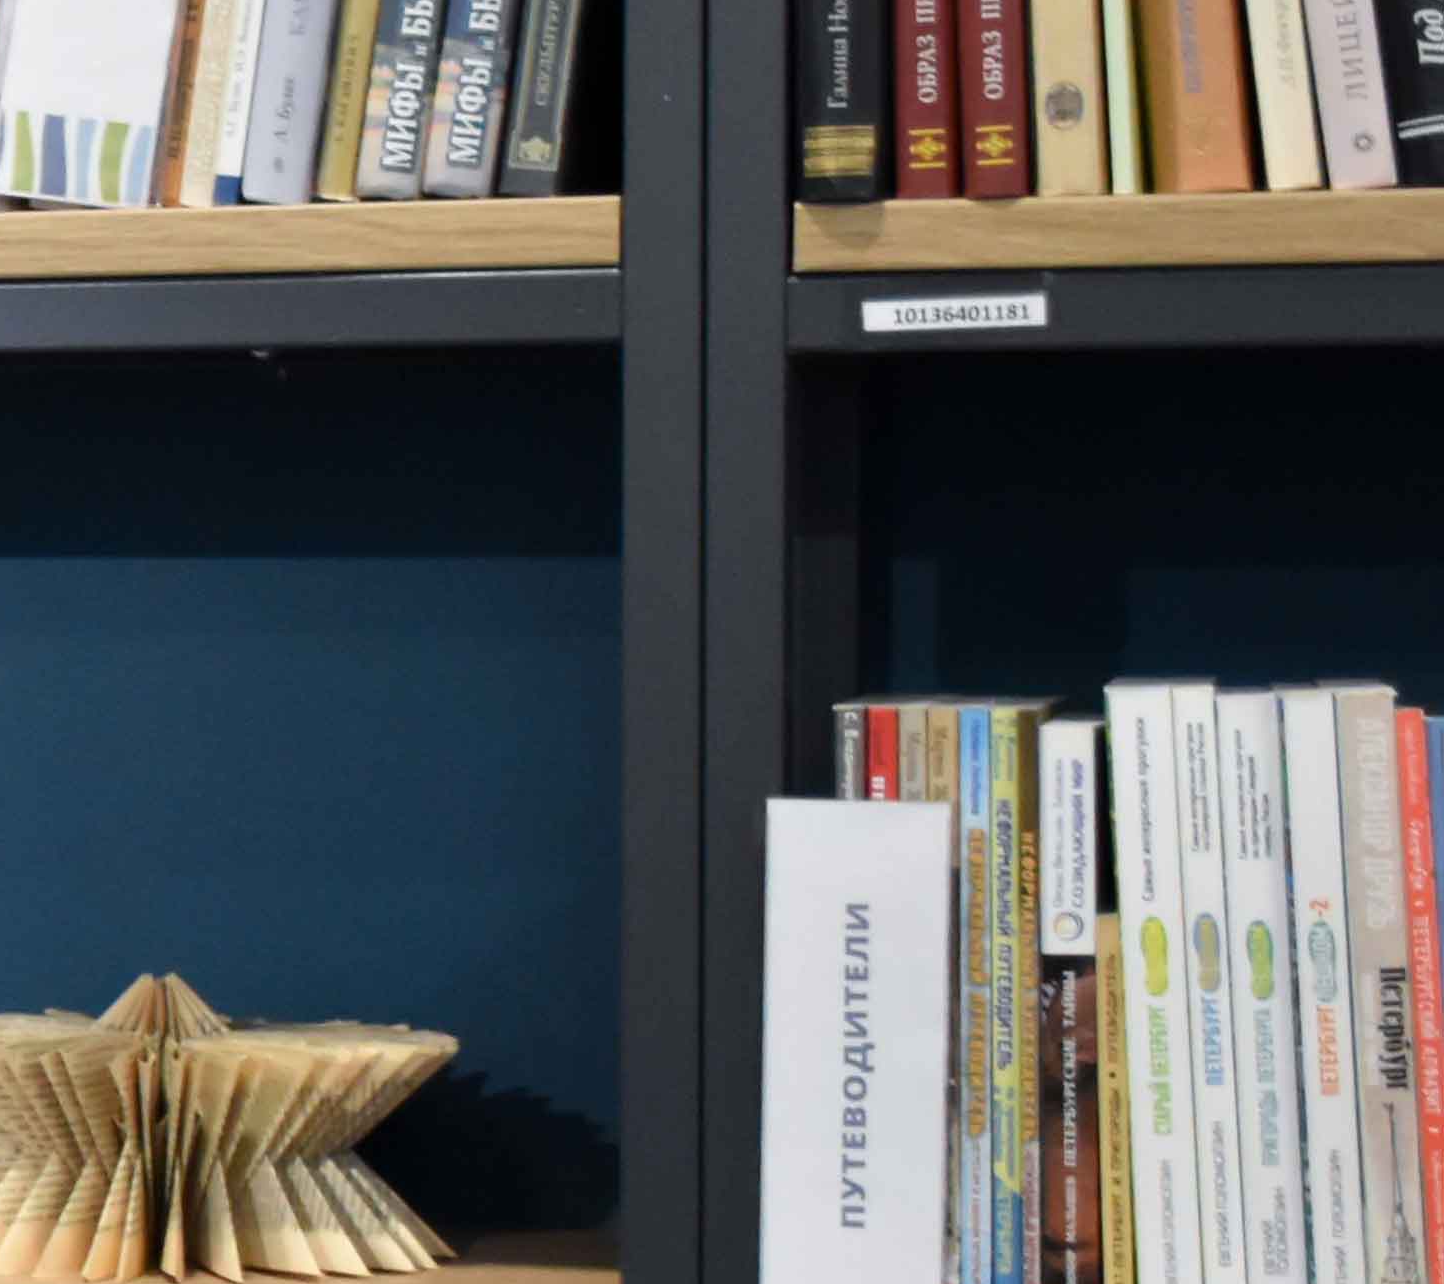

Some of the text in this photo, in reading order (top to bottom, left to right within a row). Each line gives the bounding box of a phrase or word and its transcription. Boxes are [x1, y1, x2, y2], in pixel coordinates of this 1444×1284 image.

[917, 34, 939, 103] ОБРАЗ
[982, 31, 1004, 100] ОБРАЗ
[1415, 8, 1443, 65] Под
[381, 64, 426, 169] МИФЫ
[449, 58, 492, 163] МИФЫ
[893, 303, 1030, 326] 10136401181
[840, 902, 874, 1229] ПУТЕВОДИТЕЛИ
[1203, 995, 1223, 1086] ПЕТЕРБУРГ
[1315, 1006, 1341, 1096] ПЕТЕРБУРГ
[1379, 965, 1409, 1090] Петербург
